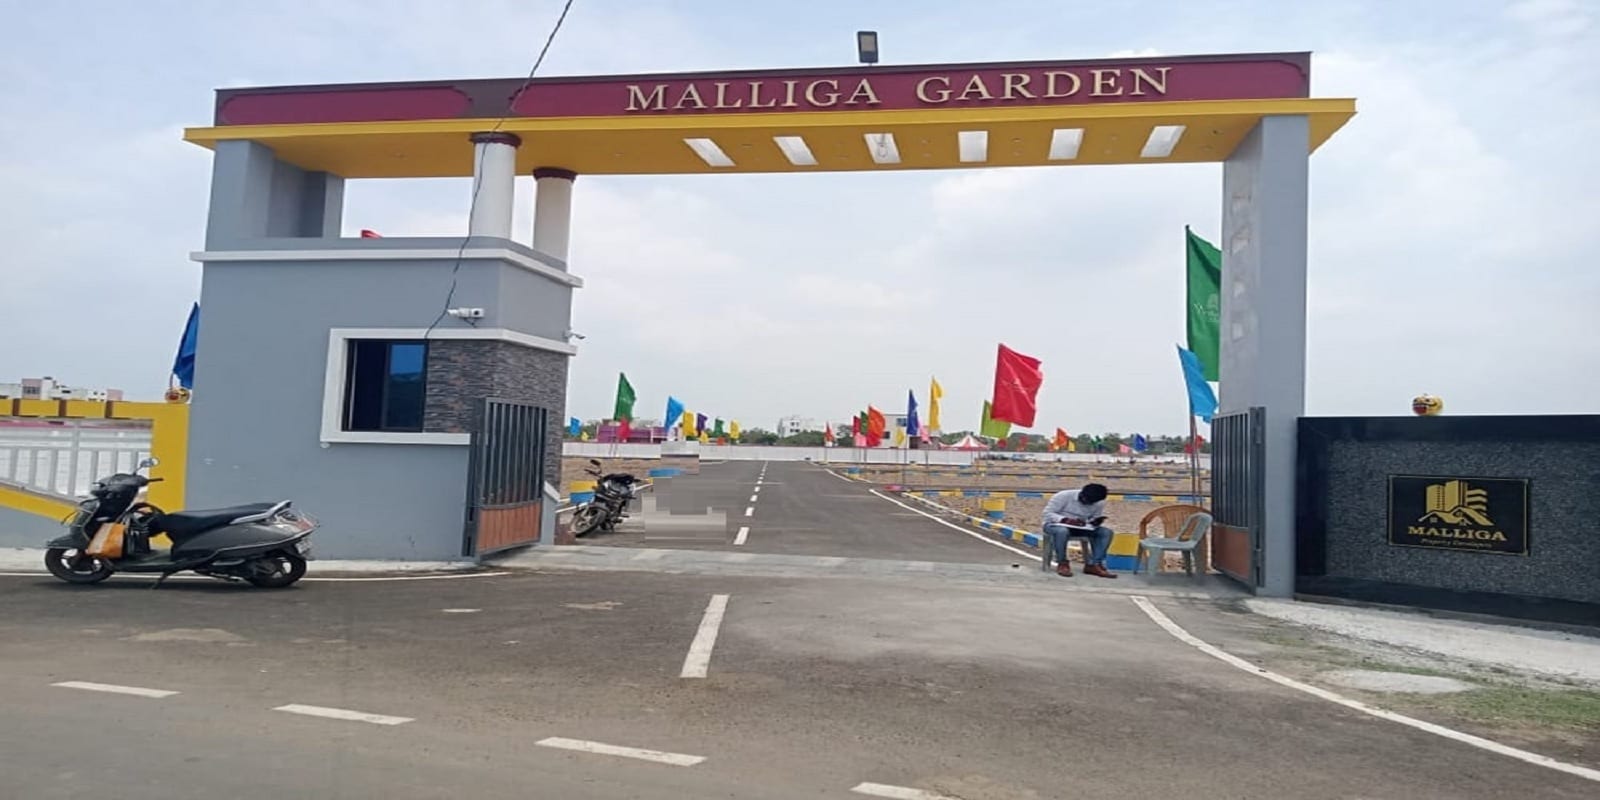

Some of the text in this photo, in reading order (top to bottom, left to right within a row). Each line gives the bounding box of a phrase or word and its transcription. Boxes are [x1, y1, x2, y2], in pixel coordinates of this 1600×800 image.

[625, 67, 1172, 111] MALLIGA GARDEN
[1408, 526, 1507, 541] MALLIGA
